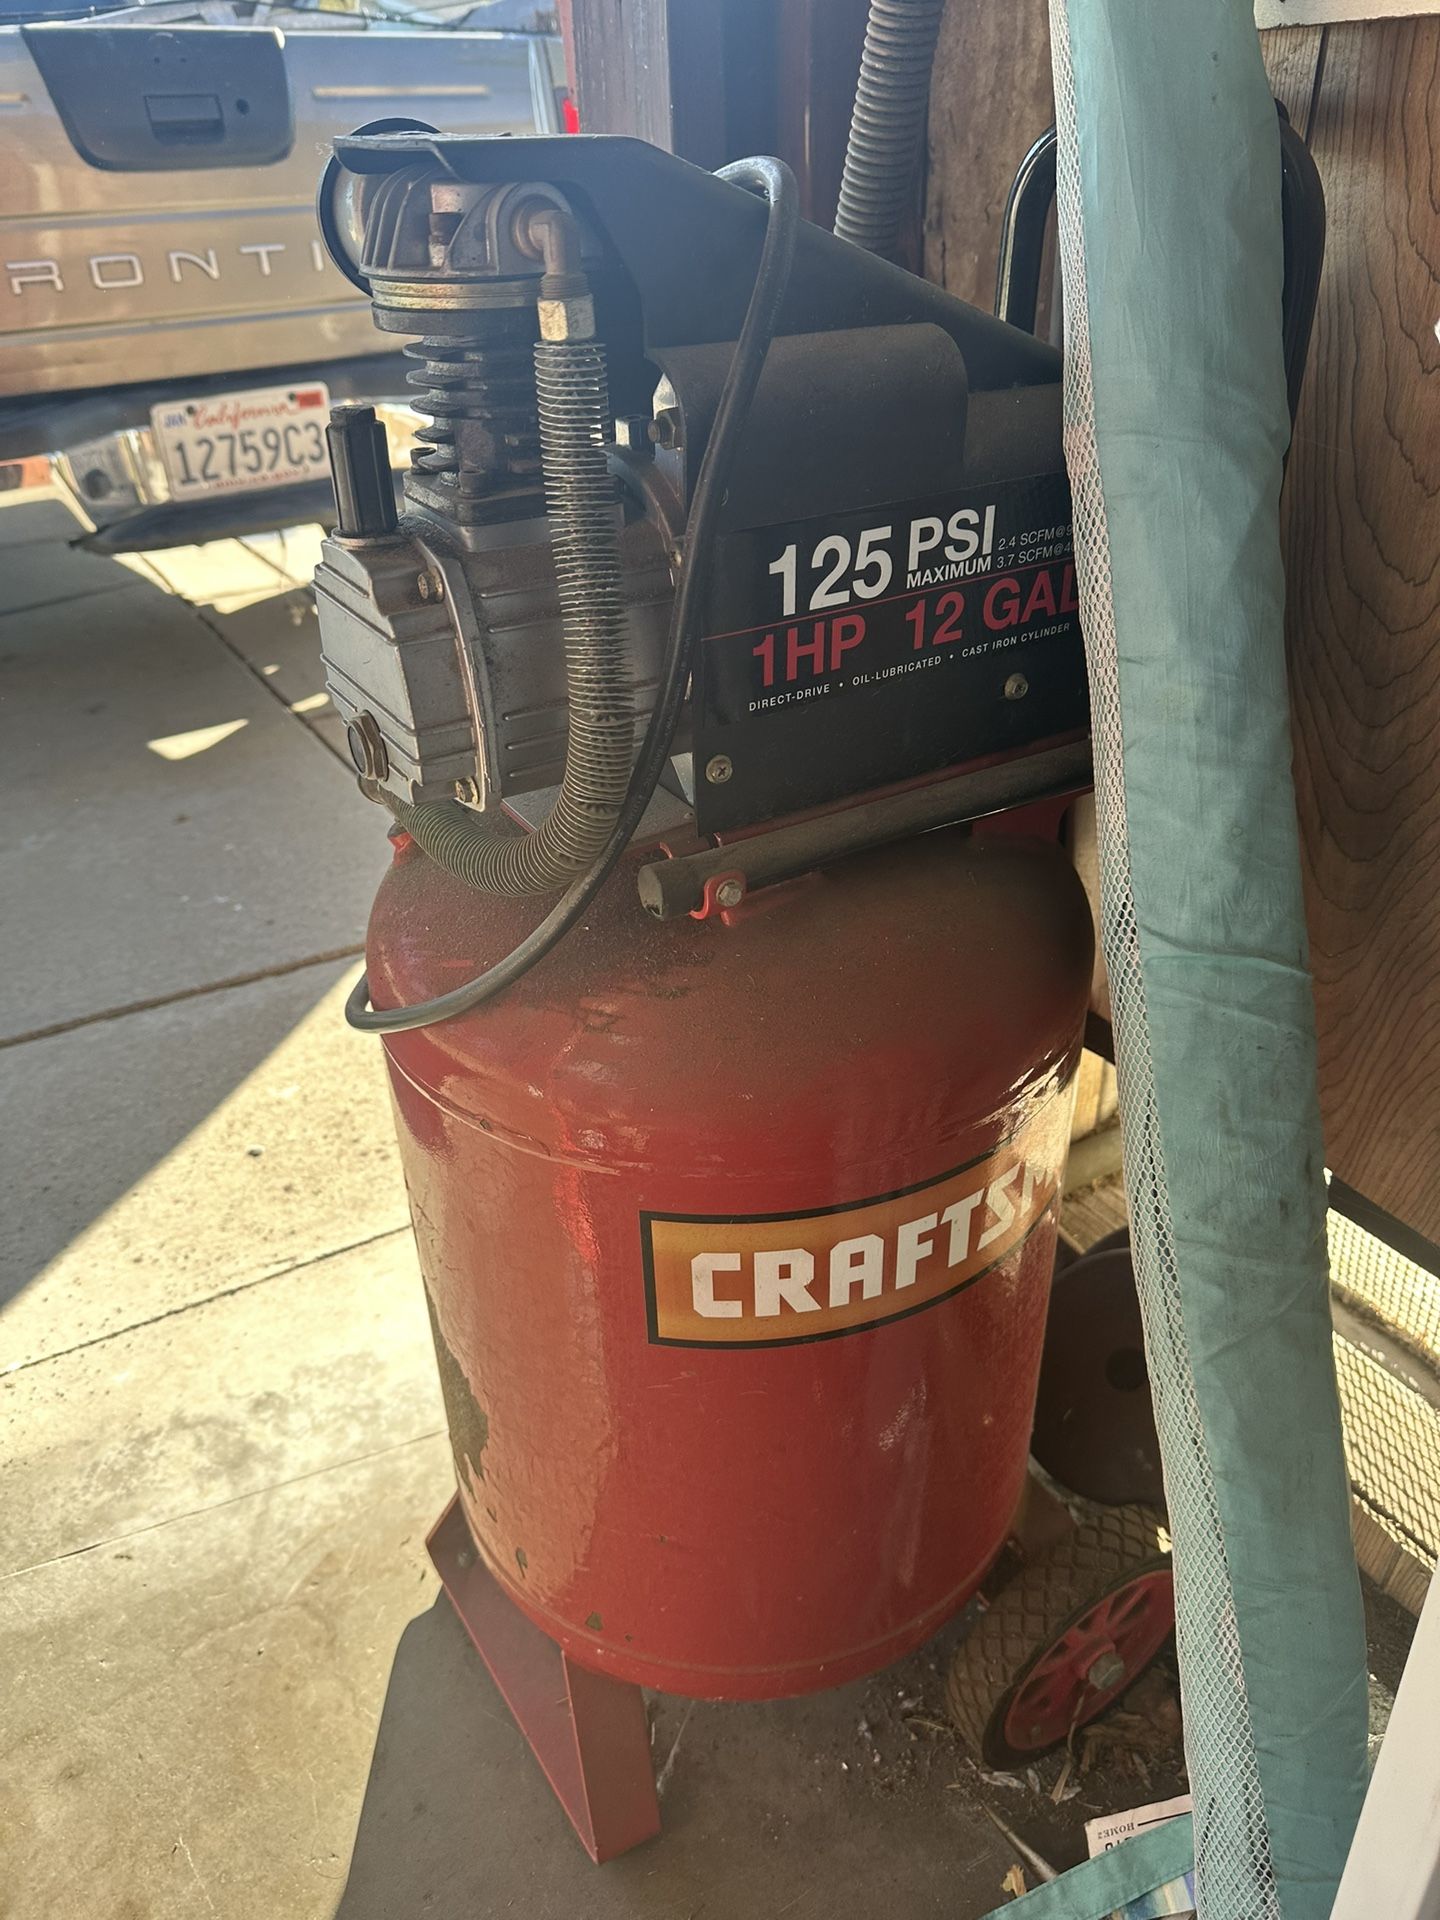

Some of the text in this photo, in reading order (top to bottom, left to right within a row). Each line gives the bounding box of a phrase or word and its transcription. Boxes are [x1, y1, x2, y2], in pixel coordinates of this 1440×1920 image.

[175, 420, 326, 485] 12759C3
[768, 504, 996, 617] 125 PSI
[906, 554, 992, 589] MAXIMUM
[996, 541, 1074, 569] 3.7 SCFM@4
[998, 535, 1017, 551] 2.4
[752, 614, 866, 687] 1HP
[905, 591, 965, 650] 12
[983, 564, 1079, 631] GAL
[749, 622, 1071, 712] DIRECT-DRIVE OIL-LUBRICATED CAST IRON CYLINDER
